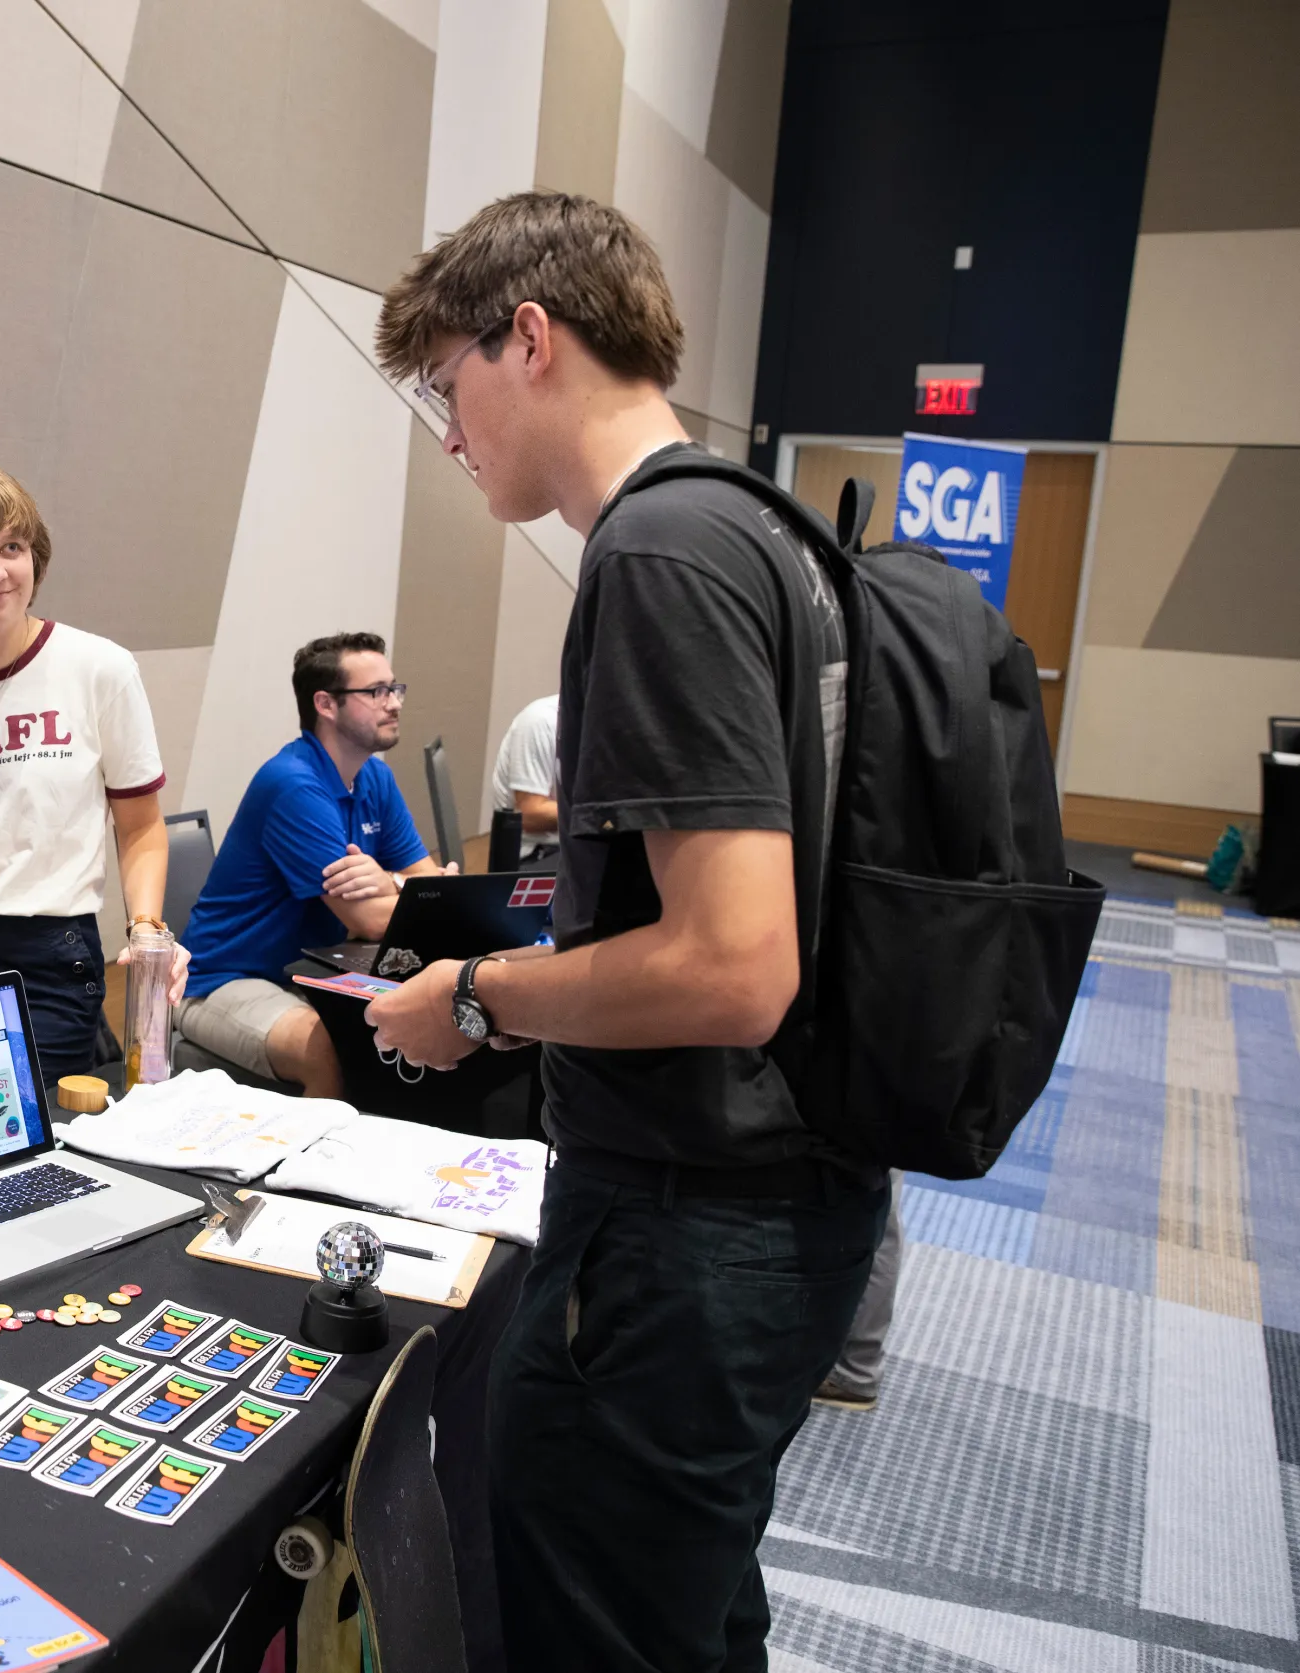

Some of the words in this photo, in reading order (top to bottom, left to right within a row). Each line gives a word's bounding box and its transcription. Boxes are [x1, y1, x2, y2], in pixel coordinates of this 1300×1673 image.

[925, 380, 971, 411] EXIT
[900, 461, 1003, 544] SGA
[14, 753, 30, 762] left
[38, 751, 57, 759] 88.1
[60, 750, 72, 759] fm
[144, 1328, 157, 1338] FM
[210, 1345, 222, 1355] FM
[70, 1374, 85, 1385] FM
[273, 1370, 283, 1379] FM
[143, 1395, 158, 1405] FM
[215, 1422, 229, 1438] FM
[63, 1453, 81, 1464] FM
[138, 1482, 153, 1494] FM
